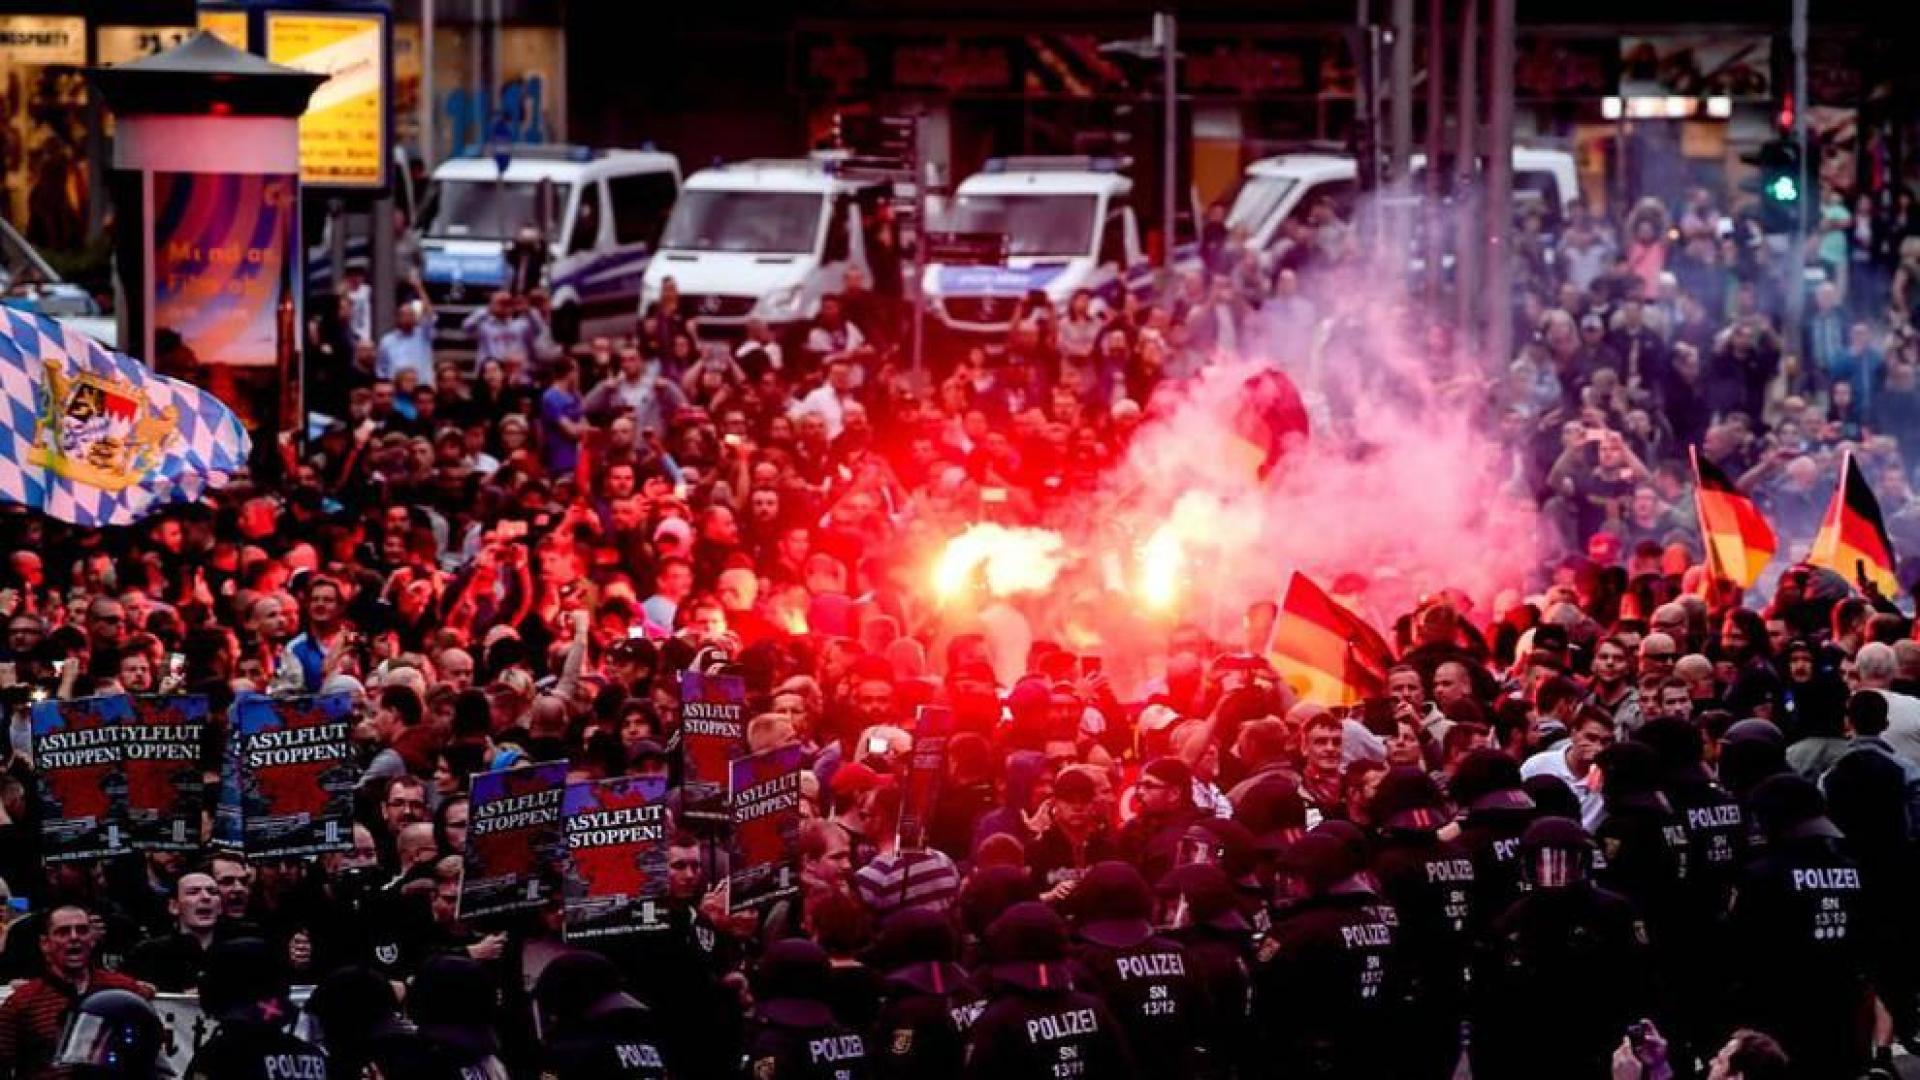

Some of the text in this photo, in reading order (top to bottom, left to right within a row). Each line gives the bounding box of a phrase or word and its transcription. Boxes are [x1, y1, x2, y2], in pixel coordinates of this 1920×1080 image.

[682, 703, 740, 719] ASYLFLUT
[39, 726, 119, 751] ASYLFLUT
[121, 725, 203, 741] YLFLUT
[247, 723, 348, 750] ASYLFLUT
[684, 718, 742, 737] STOPPEN!
[42, 746, 121, 768] STOPPEN!
[124, 743, 201, 759] OPPEN!
[249, 743, 346, 767] STOPPEN!
[735, 773, 798, 807] ASYLFLUT
[475, 789, 560, 817] ASYLFLUT
[736, 791, 798, 824] STOPPEN!
[474, 806, 559, 834] STOPPEN!
[566, 804, 664, 832] ASYLFLUT
[568, 825, 662, 849] STOPPEN!
[1793, 867, 1862, 891] POLIZEI
[1116, 953, 1185, 981] POLIZEI
[1027, 1007, 1096, 1043] POLIZEI
